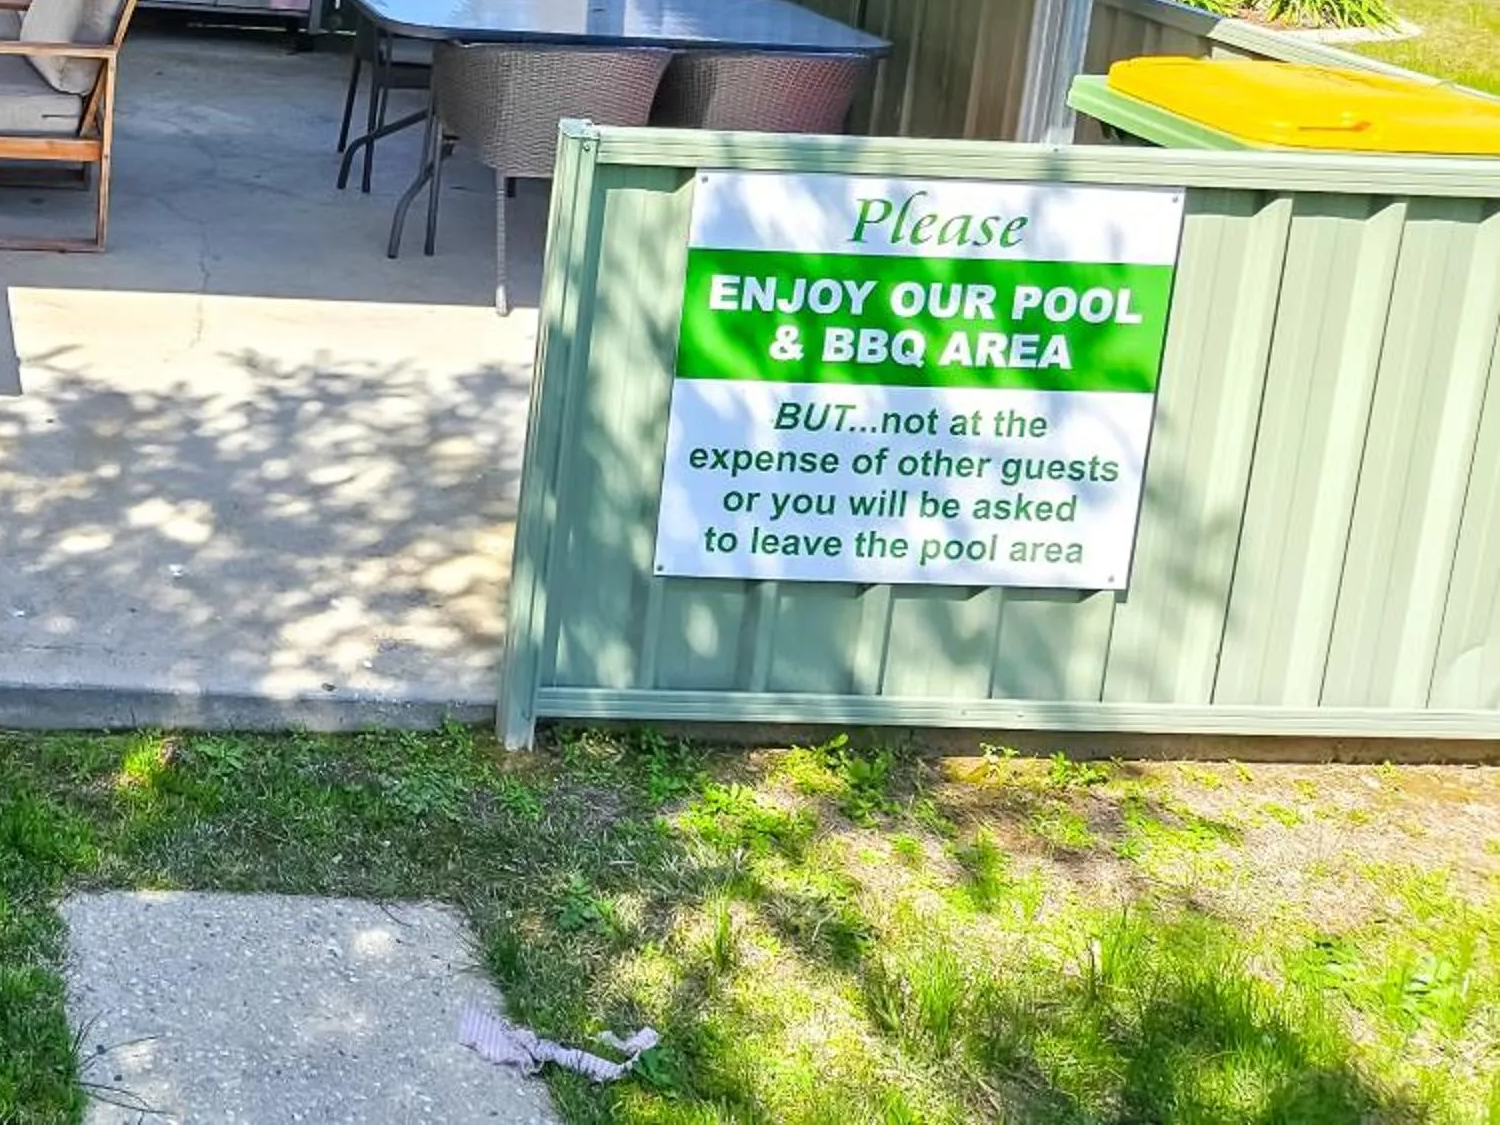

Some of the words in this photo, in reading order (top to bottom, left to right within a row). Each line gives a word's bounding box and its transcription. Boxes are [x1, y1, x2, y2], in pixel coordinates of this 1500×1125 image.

[847, 191, 1028, 247] Please
[708, 275, 878, 315] ENJOY
[890, 282, 997, 320] OUR
[1012, 286, 1142, 324] POOL
[769, 325, 804, 360] &
[822, 328, 925, 367] BBQ
[939, 333, 1073, 370] AREA
[949, 411, 982, 436] at
[993, 409, 1048, 438] the
[689, 447, 839, 478] expense
[852, 447, 887, 475] of
[898, 450, 991, 478] other
[1001, 453, 1119, 486] guests
[723, 490, 760, 513] or
[771, 494, 836, 519] you
[849, 490, 907, 518] will
[919, 493, 960, 519] be
[973, 494, 1077, 522] asked
[705, 530, 738, 553] to
[751, 528, 842, 556] leave
[855, 531, 908, 558] the
[920, 535, 997, 566] pool
[1009, 541, 1084, 564] area
